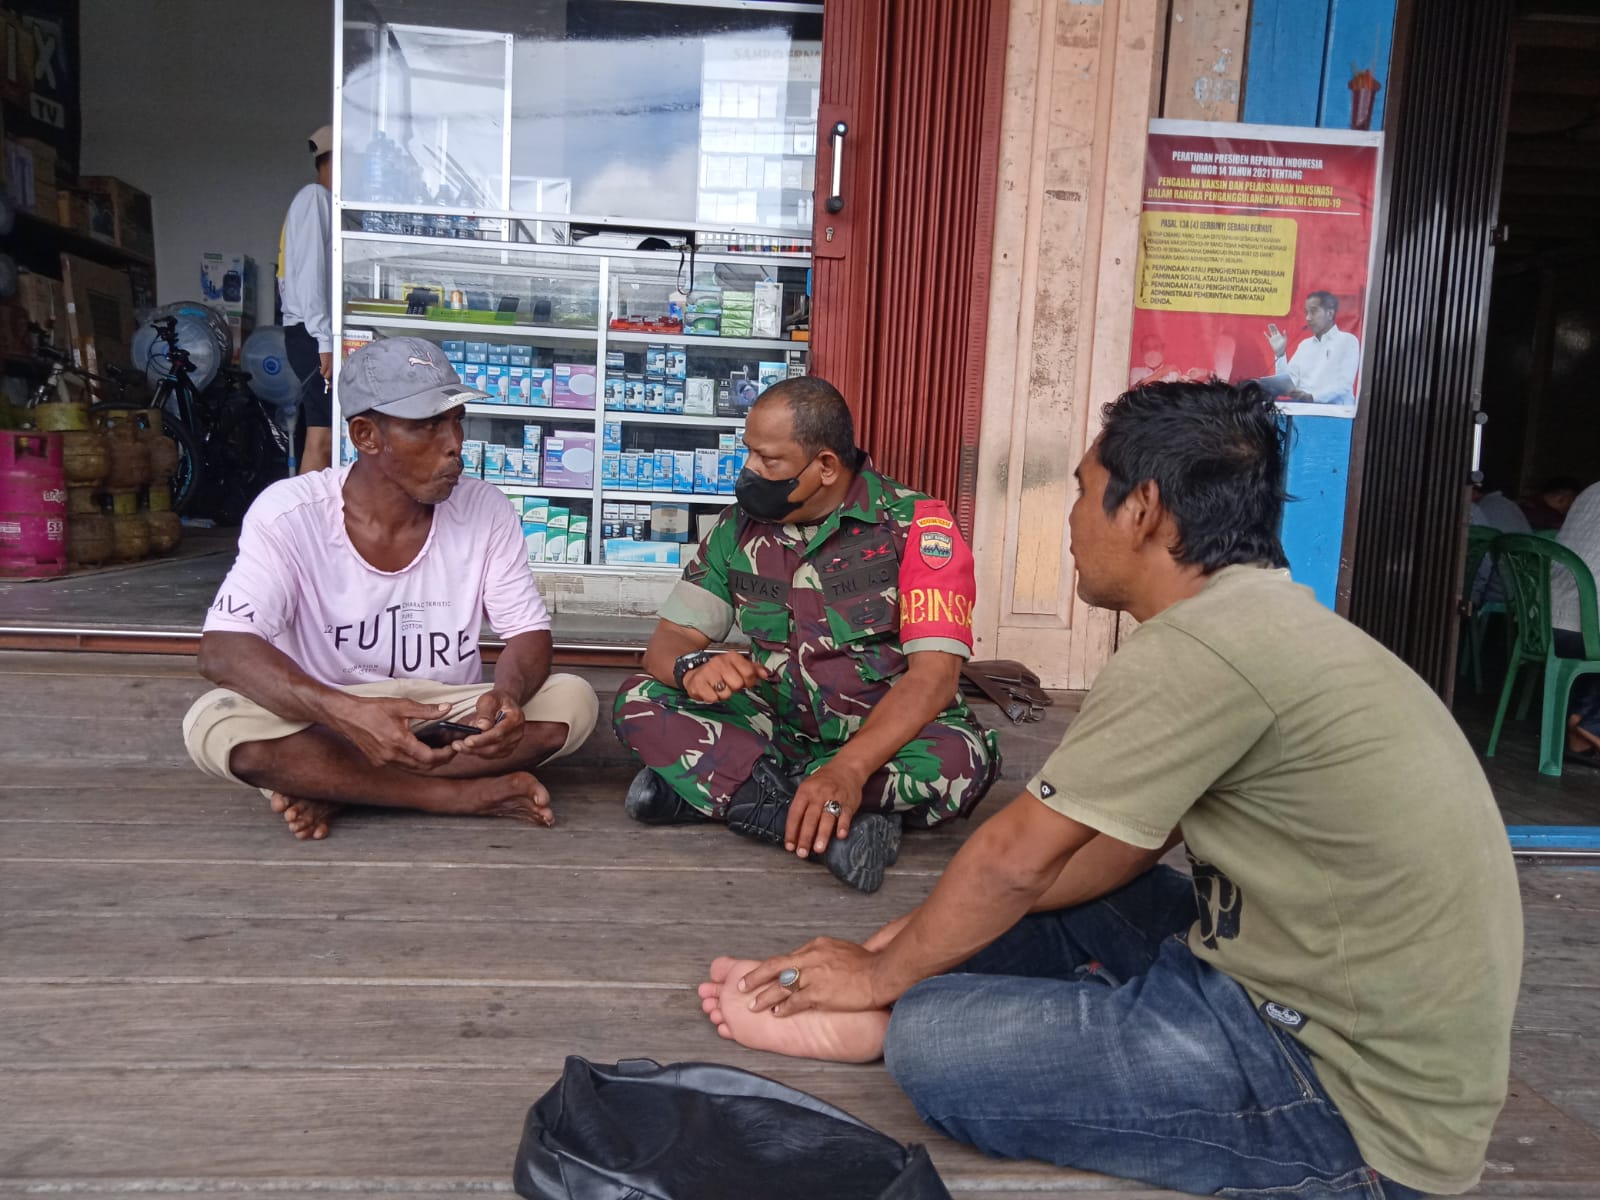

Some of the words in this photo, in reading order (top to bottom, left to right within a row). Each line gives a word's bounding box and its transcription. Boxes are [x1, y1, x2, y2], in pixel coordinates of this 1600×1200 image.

[1172, 151, 1213, 162] PERATURAN
[1214, 153, 1249, 165] PRESIDEN
[1250, 155, 1284, 167] REPUBLIK
[1285, 157, 1323, 169] INDONESIA
[1190, 164, 1217, 175] NOMOR
[1219, 165, 1227, 176] 14
[1228, 166, 1252, 177] TAHUN
[1252, 168, 1270, 178] 2021
[1271, 169, 1303, 180] TENTANG
[1158, 176, 1200, 188] PENGADAAN
[1201, 179, 1227, 190] VAKSIN
[1228, 181, 1244, 191] DAN
[1244, 181, 1294, 194] PELAKSANAAN
[1295, 184, 1334, 196] VAKSINASI
[1148, 188, 1173, 198] DALAM
[1173, 189, 1203, 201] RANGKA
[1203, 191, 1274, 205] PENGANGGULANGAN
[1275, 195, 1307, 206] PANDEMI
[1307, 197, 1341, 208] COVID-19
[1152, 264, 1190, 272] PENUNDAAN
[1207, 267, 1249, 275] PENGHENTIAN
[1251, 269, 1285, 277] PEMBERIAN
[1150, 290, 1193, 298] ADMINISTRASI
[1151, 281, 1189, 289] PENUNDAAN
[1206, 284, 1249, 292] PENGHENTIAN
[734, 575, 780, 599] ILYAS
[832, 581, 857, 597] TNI
[401, 623, 423, 632] COTTON
[335, 604, 476, 678] FUTURE
